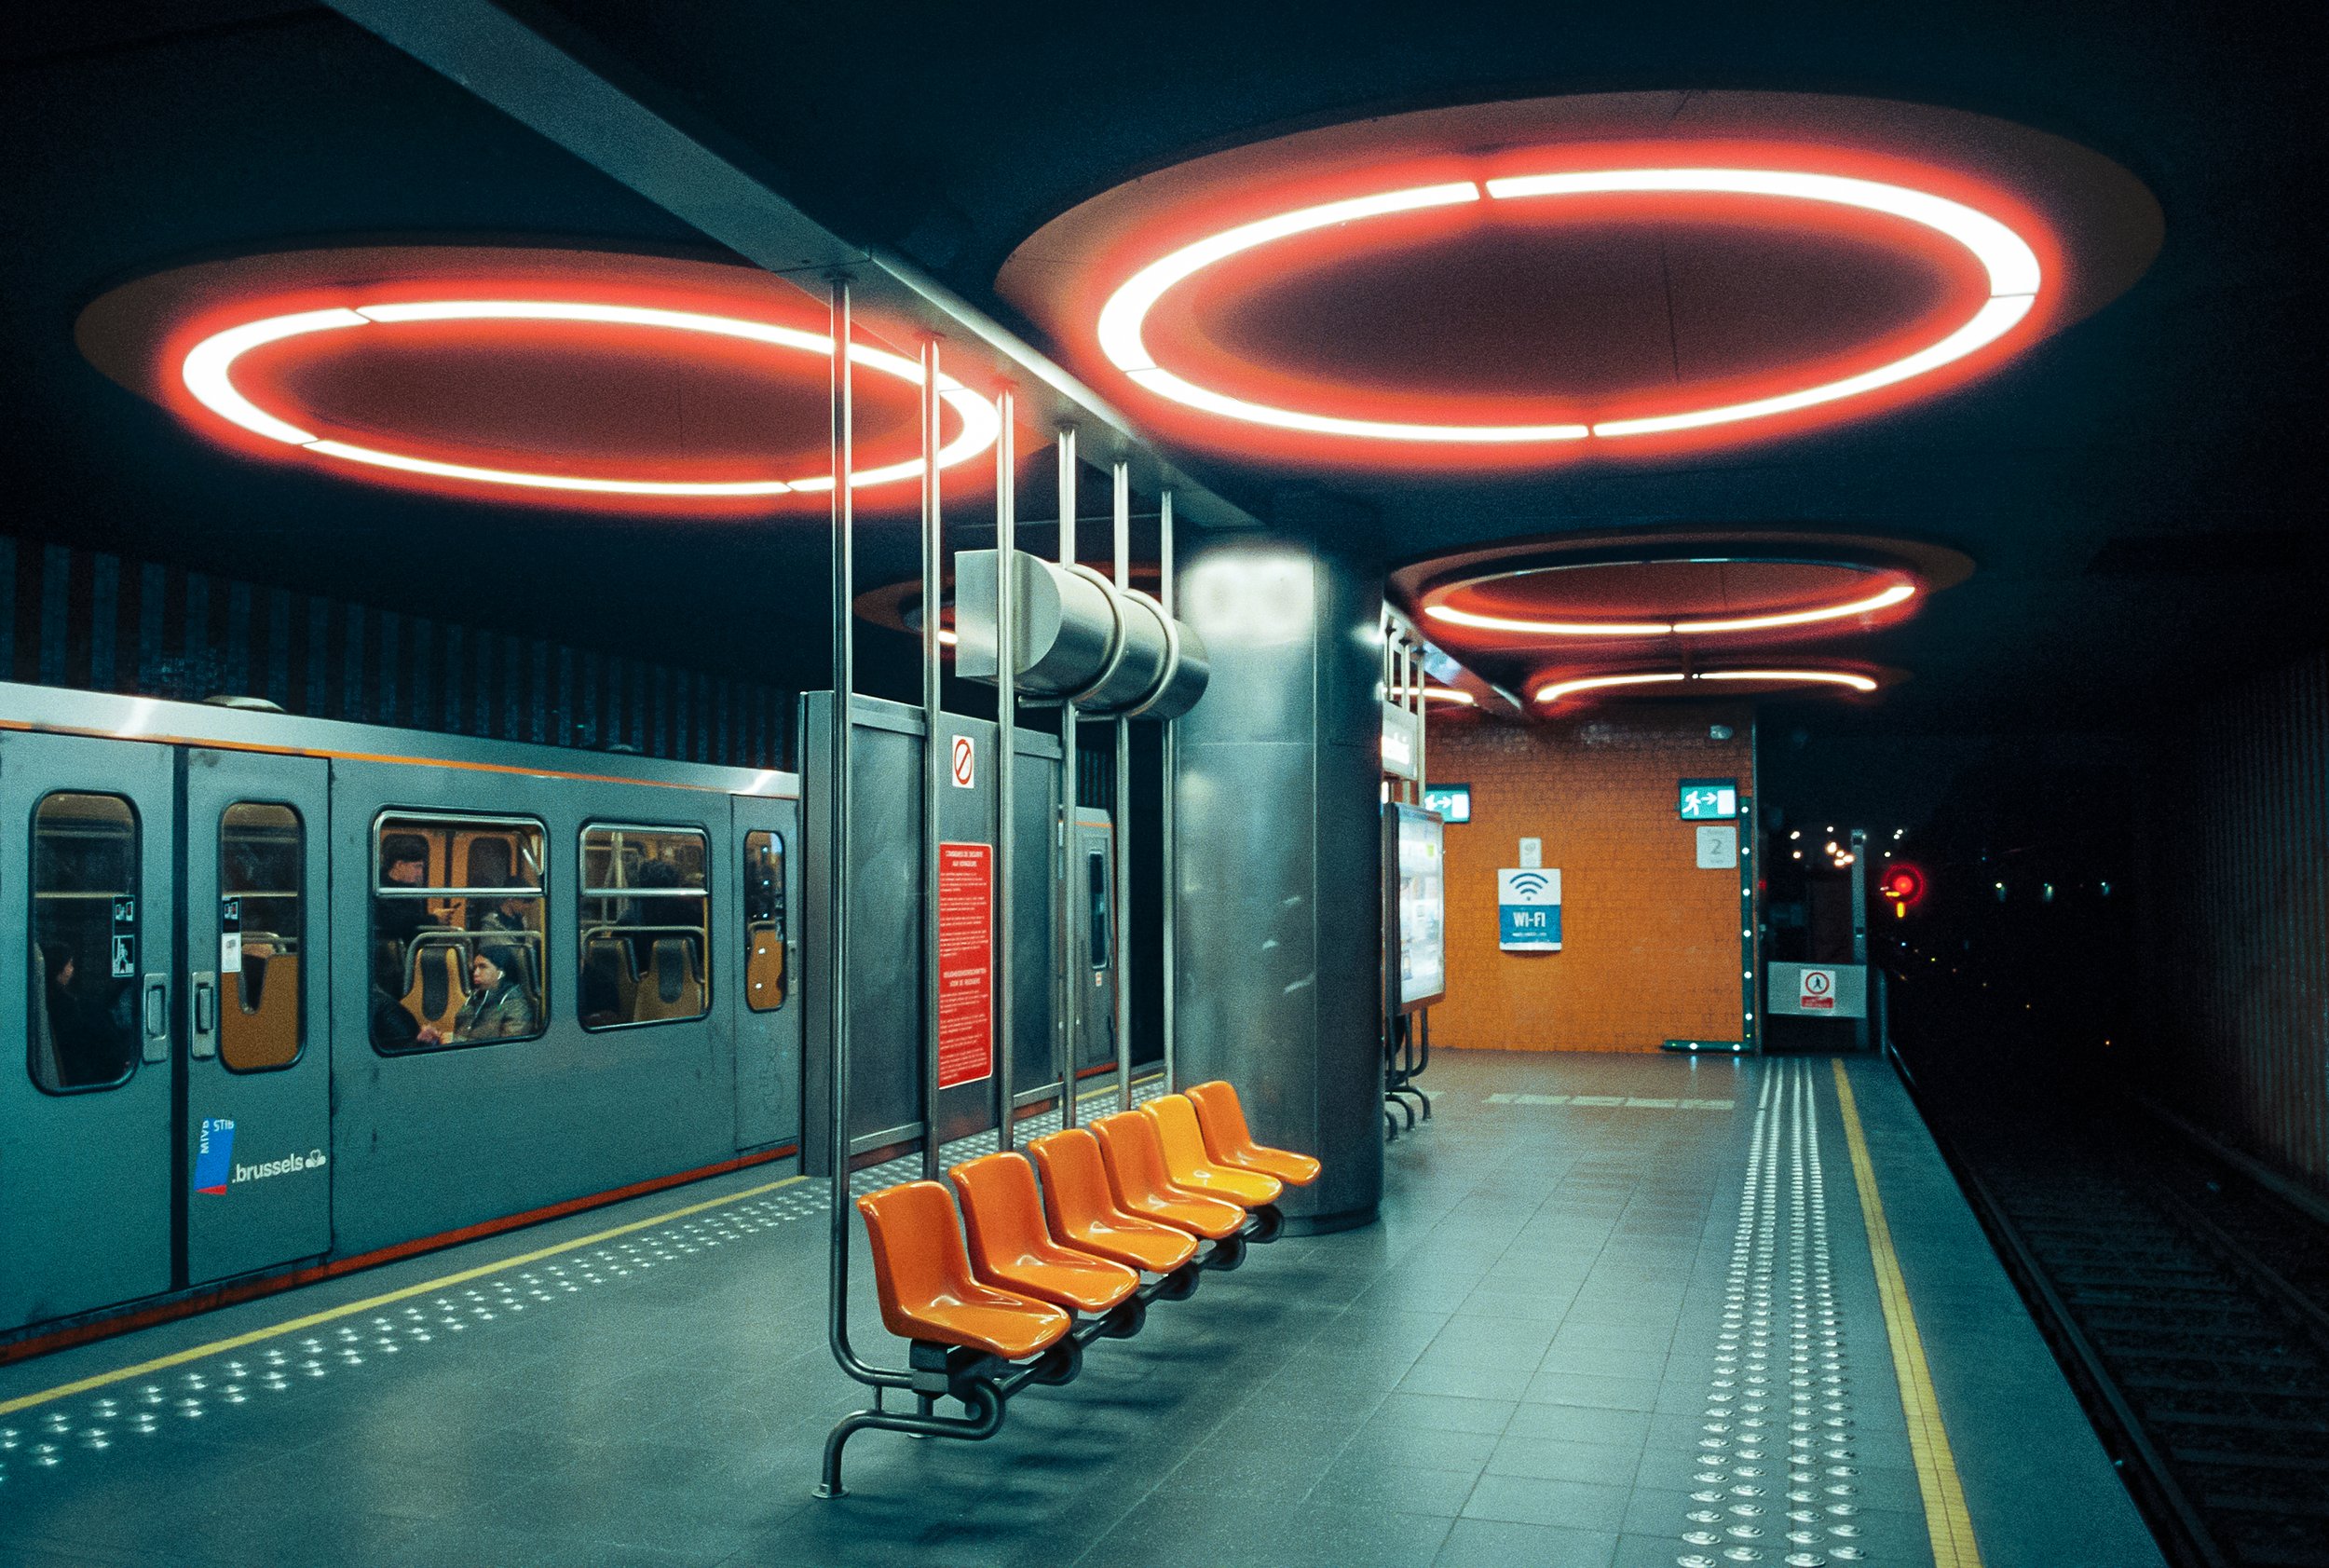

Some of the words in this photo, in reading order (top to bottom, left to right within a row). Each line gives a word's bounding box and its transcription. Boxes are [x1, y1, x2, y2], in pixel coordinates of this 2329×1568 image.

[1711, 839, 1723, 854] 2
[1513, 911, 1546, 928] WI-FI
[213, 1119, 235, 1132] STIB
[200, 1120, 210, 1154] MIVB
[232, 1153, 305, 1183] .brussels
